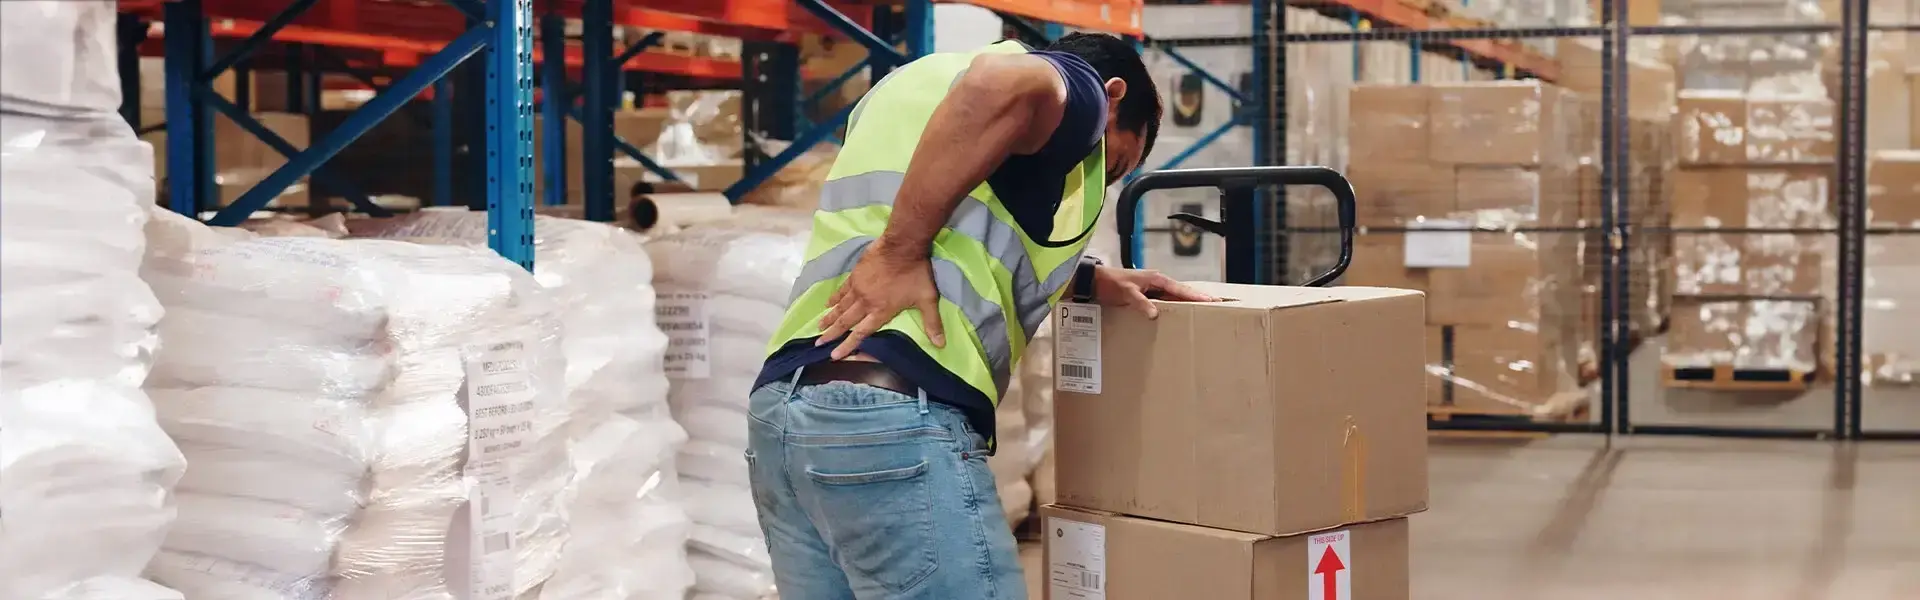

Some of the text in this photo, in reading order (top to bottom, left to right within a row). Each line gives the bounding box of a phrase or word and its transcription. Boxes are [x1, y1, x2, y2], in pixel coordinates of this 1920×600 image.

[1061, 306, 1069, 326] P
[1314, 533, 1345, 545] THIS SIDE UP
